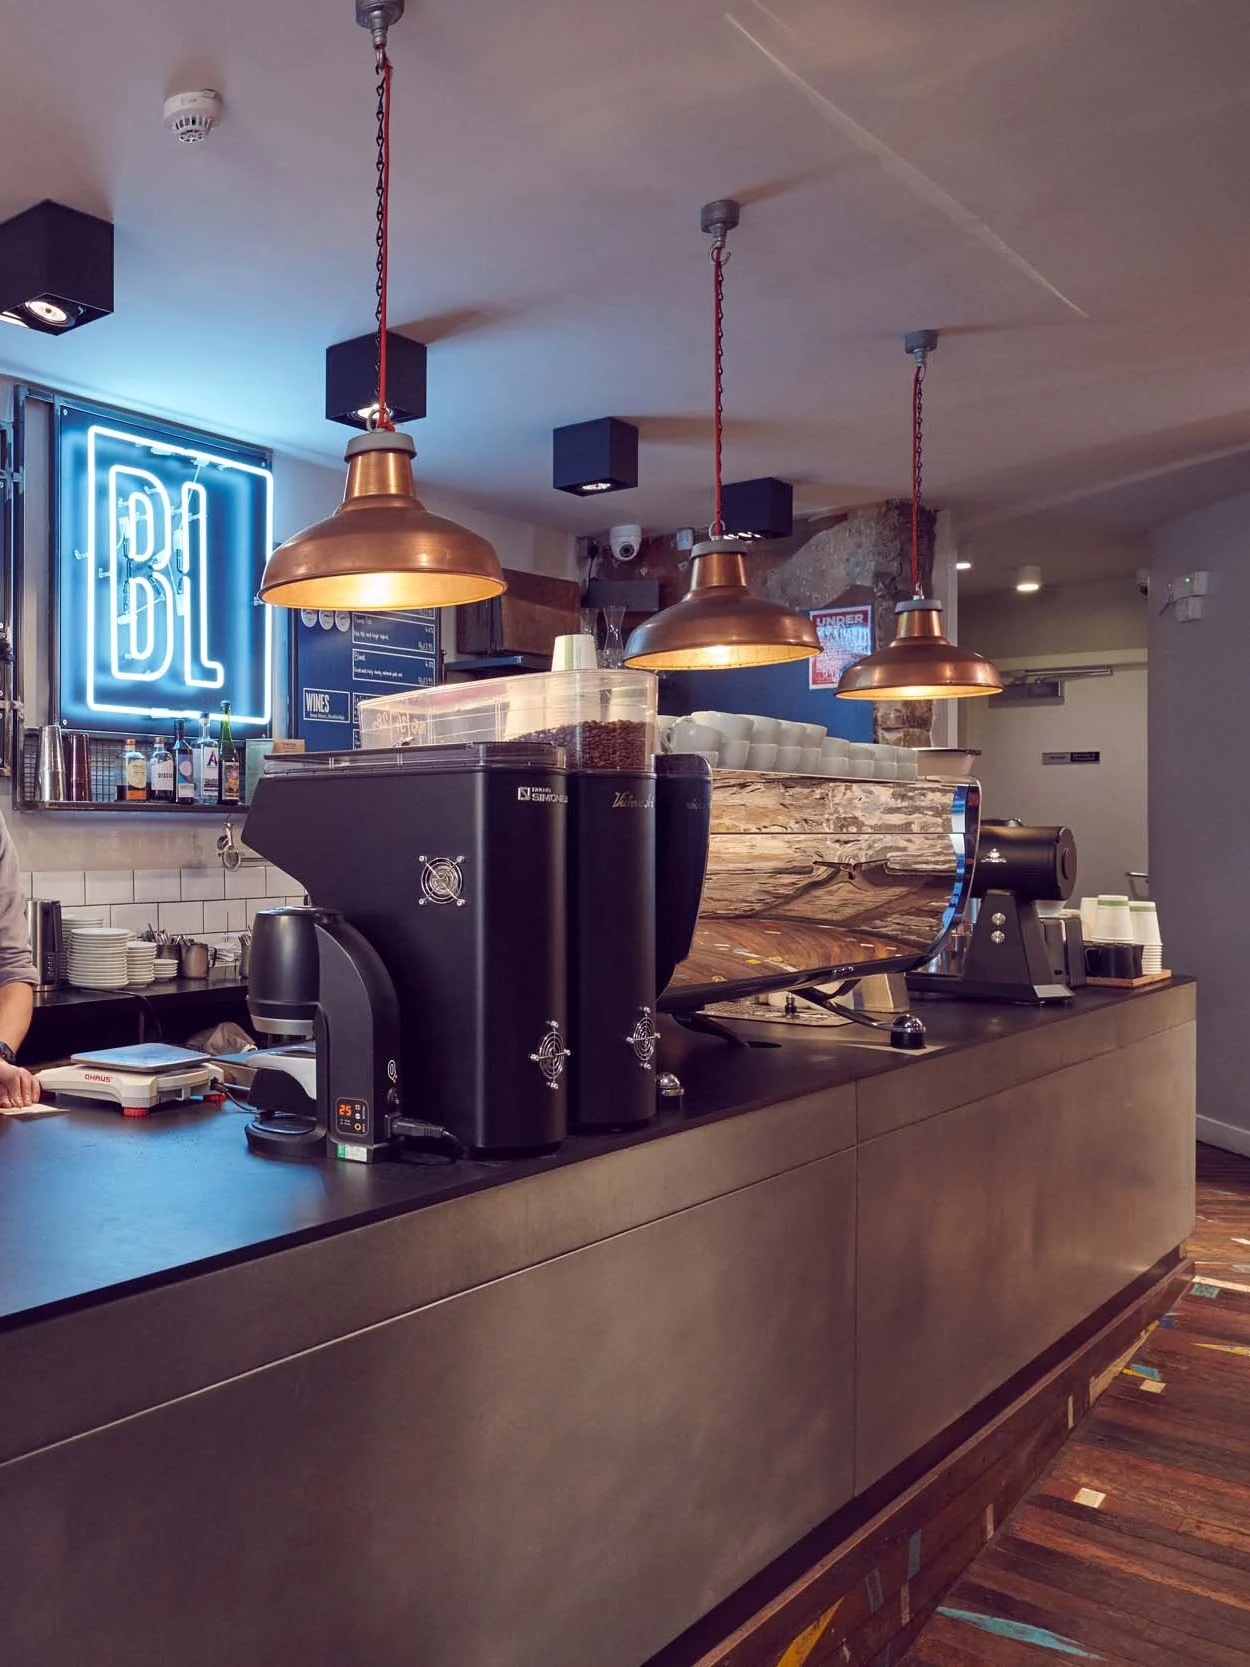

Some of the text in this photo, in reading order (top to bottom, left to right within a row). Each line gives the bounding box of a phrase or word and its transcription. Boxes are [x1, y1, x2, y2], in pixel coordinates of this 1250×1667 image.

[816, 613, 864, 626] UNDER
[305, 692, 330, 714] WINES
[84, 1073, 111, 1083] OHAUS
[338, 1104, 352, 1116] 25
